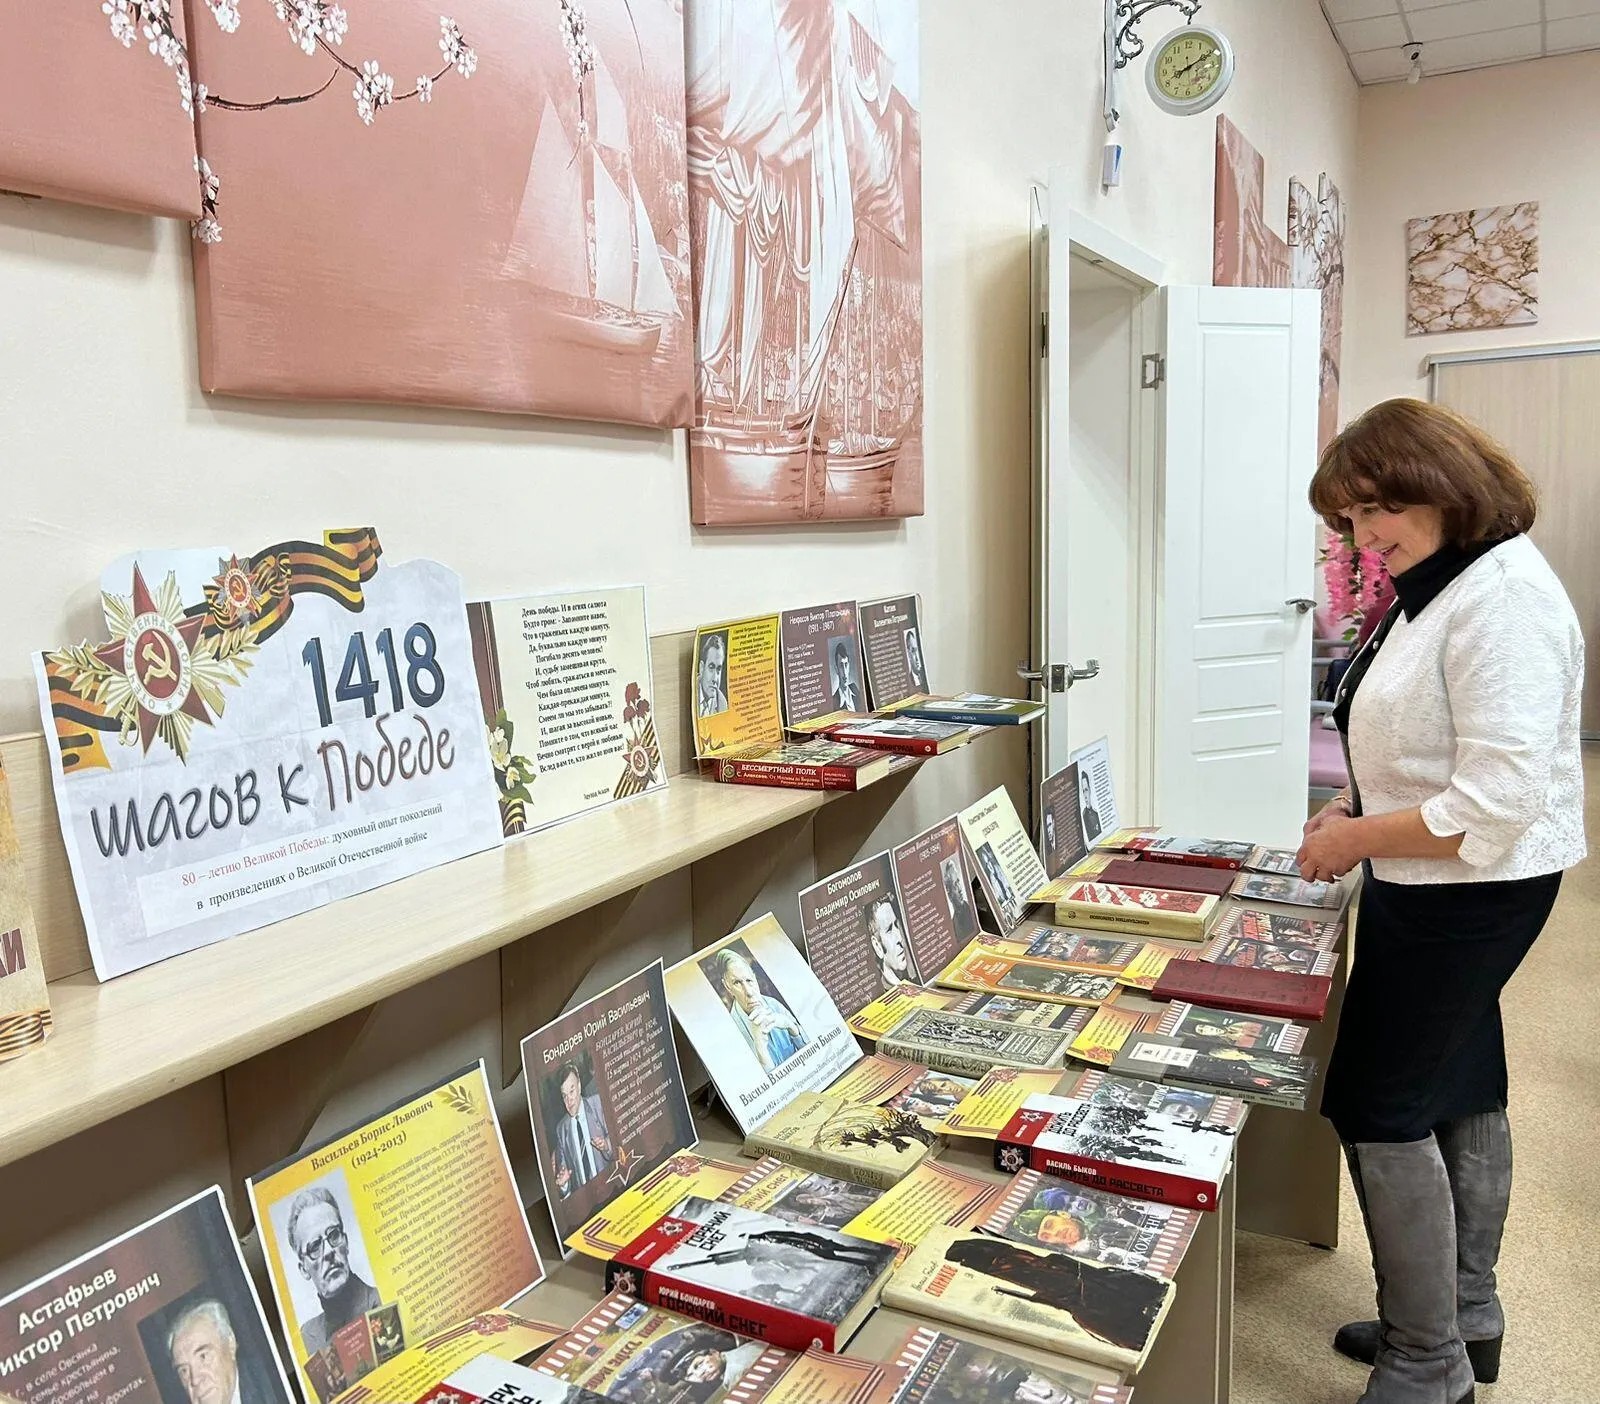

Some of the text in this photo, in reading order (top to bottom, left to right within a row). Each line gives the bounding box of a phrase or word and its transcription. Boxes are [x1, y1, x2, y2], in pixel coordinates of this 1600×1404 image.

[521, 608, 536, 617] День
[523, 620, 539, 628] Будто
[528, 644, 537, 653] Да,
[538, 641, 566, 651] буквально
[536, 653, 560, 662] Погибало
[302, 621, 445, 727] 1418
[525, 679, 539, 688] Чтоб
[562, 672, 589, 683] сражаться
[542, 664, 558, 675] судьбу
[538, 714, 556, 723] Смеем
[536, 734, 622, 760] Вечно смотрят верой любовью
[539, 737, 563, 747] Помните
[590, 724, 608, 734] всякий
[277, 763, 309, 814] к
[317, 712, 455, 811] Победе
[539, 763, 556, 772] Вслед
[742, 764, 817, 776] БЕССМЕРТНЫЙ ПОЛК
[182, 872, 196, 886] 80
[244, 846, 288, 868] Великой
[288, 836, 330, 856] Победы:
[332, 822, 376, 845] духовный
[378, 817, 398, 834] опыт
[399, 803, 443, 825] поколений
[196, 830, 429, 910] в произведениях о Великой Отечественной войне
[827, 871, 861, 894] Богомолов
[814, 879, 879, 919] Владимир Осипович
[543, 991, 649, 1062] Бондарев Юрий Васильевич
[739, 1083, 769, 1106] Василь
[766, 1043, 819, 1084] Владимирович
[817, 1027, 841, 1046] Быков
[311, 1101, 432, 1170] Васильев Борис Львович
[351, 1131, 406, 1168] (1924-2013)
[1046, 1159, 1096, 1176] ВАСИЛЬ БЫКОВ
[766, 1174, 787, 1189] СНЕГ
[1092, 1174, 1106, 1185] ДО
[1109, 1178, 1164, 1197] РАССВЕТА
[698, 1229, 727, 1251] СНЕГ
[18, 1268, 118, 1334] Астафьев
[658, 1286, 716, 1309] ЮРИЙ БОНДАРЕВ
[0, 1273, 162, 1377] иктор Петрович
[729, 1314, 768, 1337] СНЕГ
[26, 1382, 33, 1392] в
[34, 1368, 58, 1386] селе
[58, 1343, 98, 1371] Овсянка
[108, 1364, 115, 1373] в
[916, 1338, 956, 1388] КРЕПОСТЬ
[30, 1346, 120, 1404] семье крестьянина.
[86, 1390, 100, 1402] на
